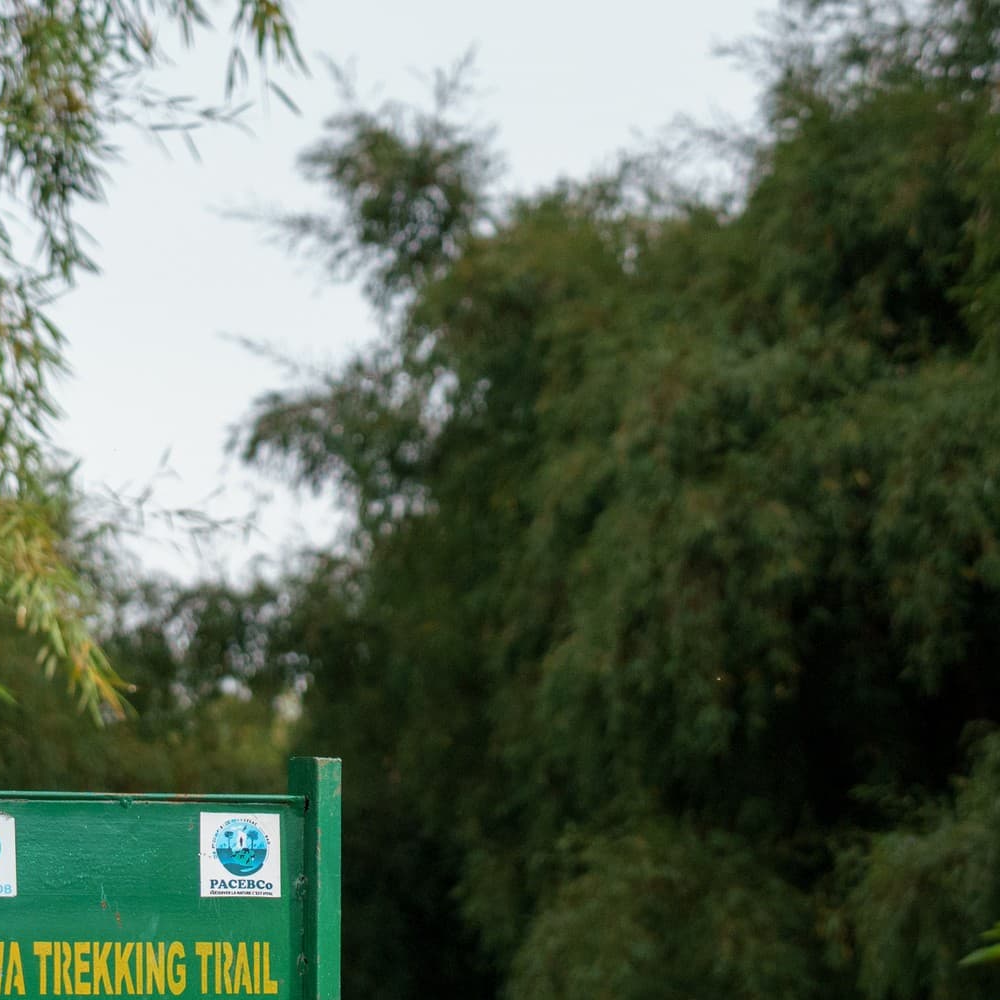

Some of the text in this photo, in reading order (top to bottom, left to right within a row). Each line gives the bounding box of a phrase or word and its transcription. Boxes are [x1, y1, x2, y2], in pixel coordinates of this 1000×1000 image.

[209, 879, 273, 890] PACEBCo
[33, 941, 187, 996] TREKKING
[195, 941, 279, 995] TRAIL
